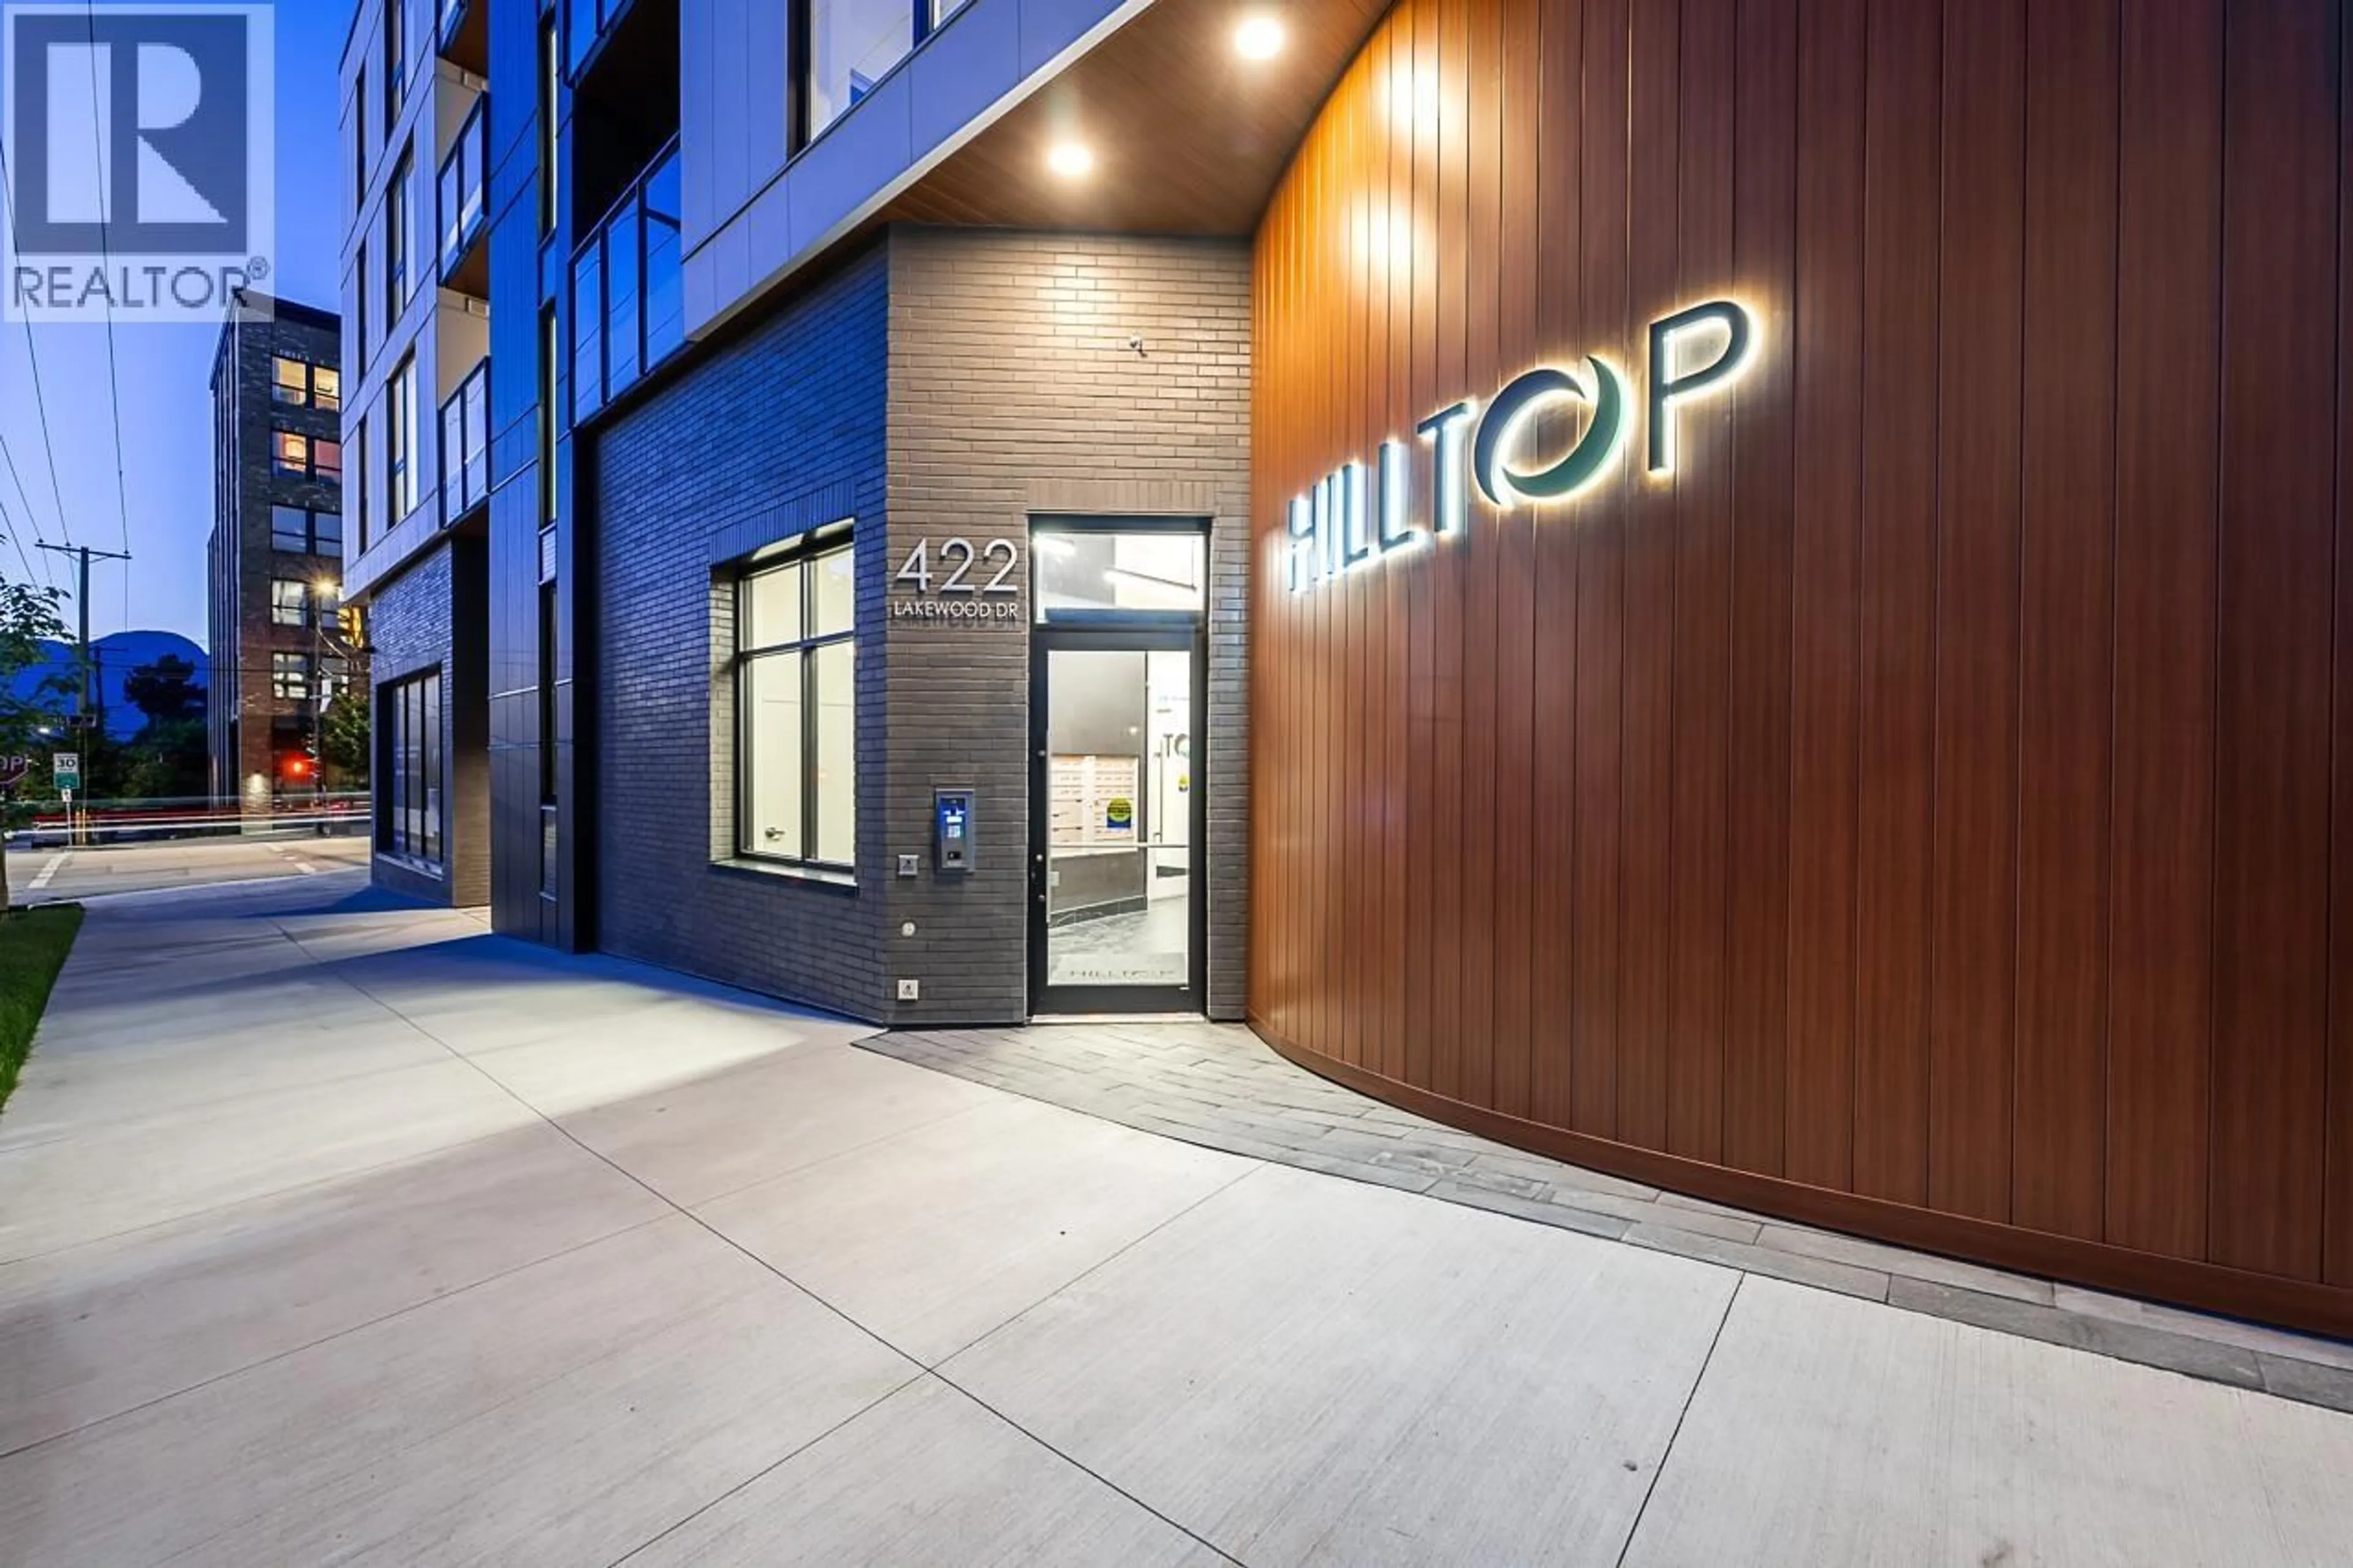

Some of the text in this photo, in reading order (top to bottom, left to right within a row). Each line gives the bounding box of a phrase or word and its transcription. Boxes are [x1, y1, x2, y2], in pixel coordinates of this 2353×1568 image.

[1288, 300, 1750, 592] HILLTOP
[896, 537, 1018, 591] 422
[895, 601, 1018, 618] LAKEWOOD DR
